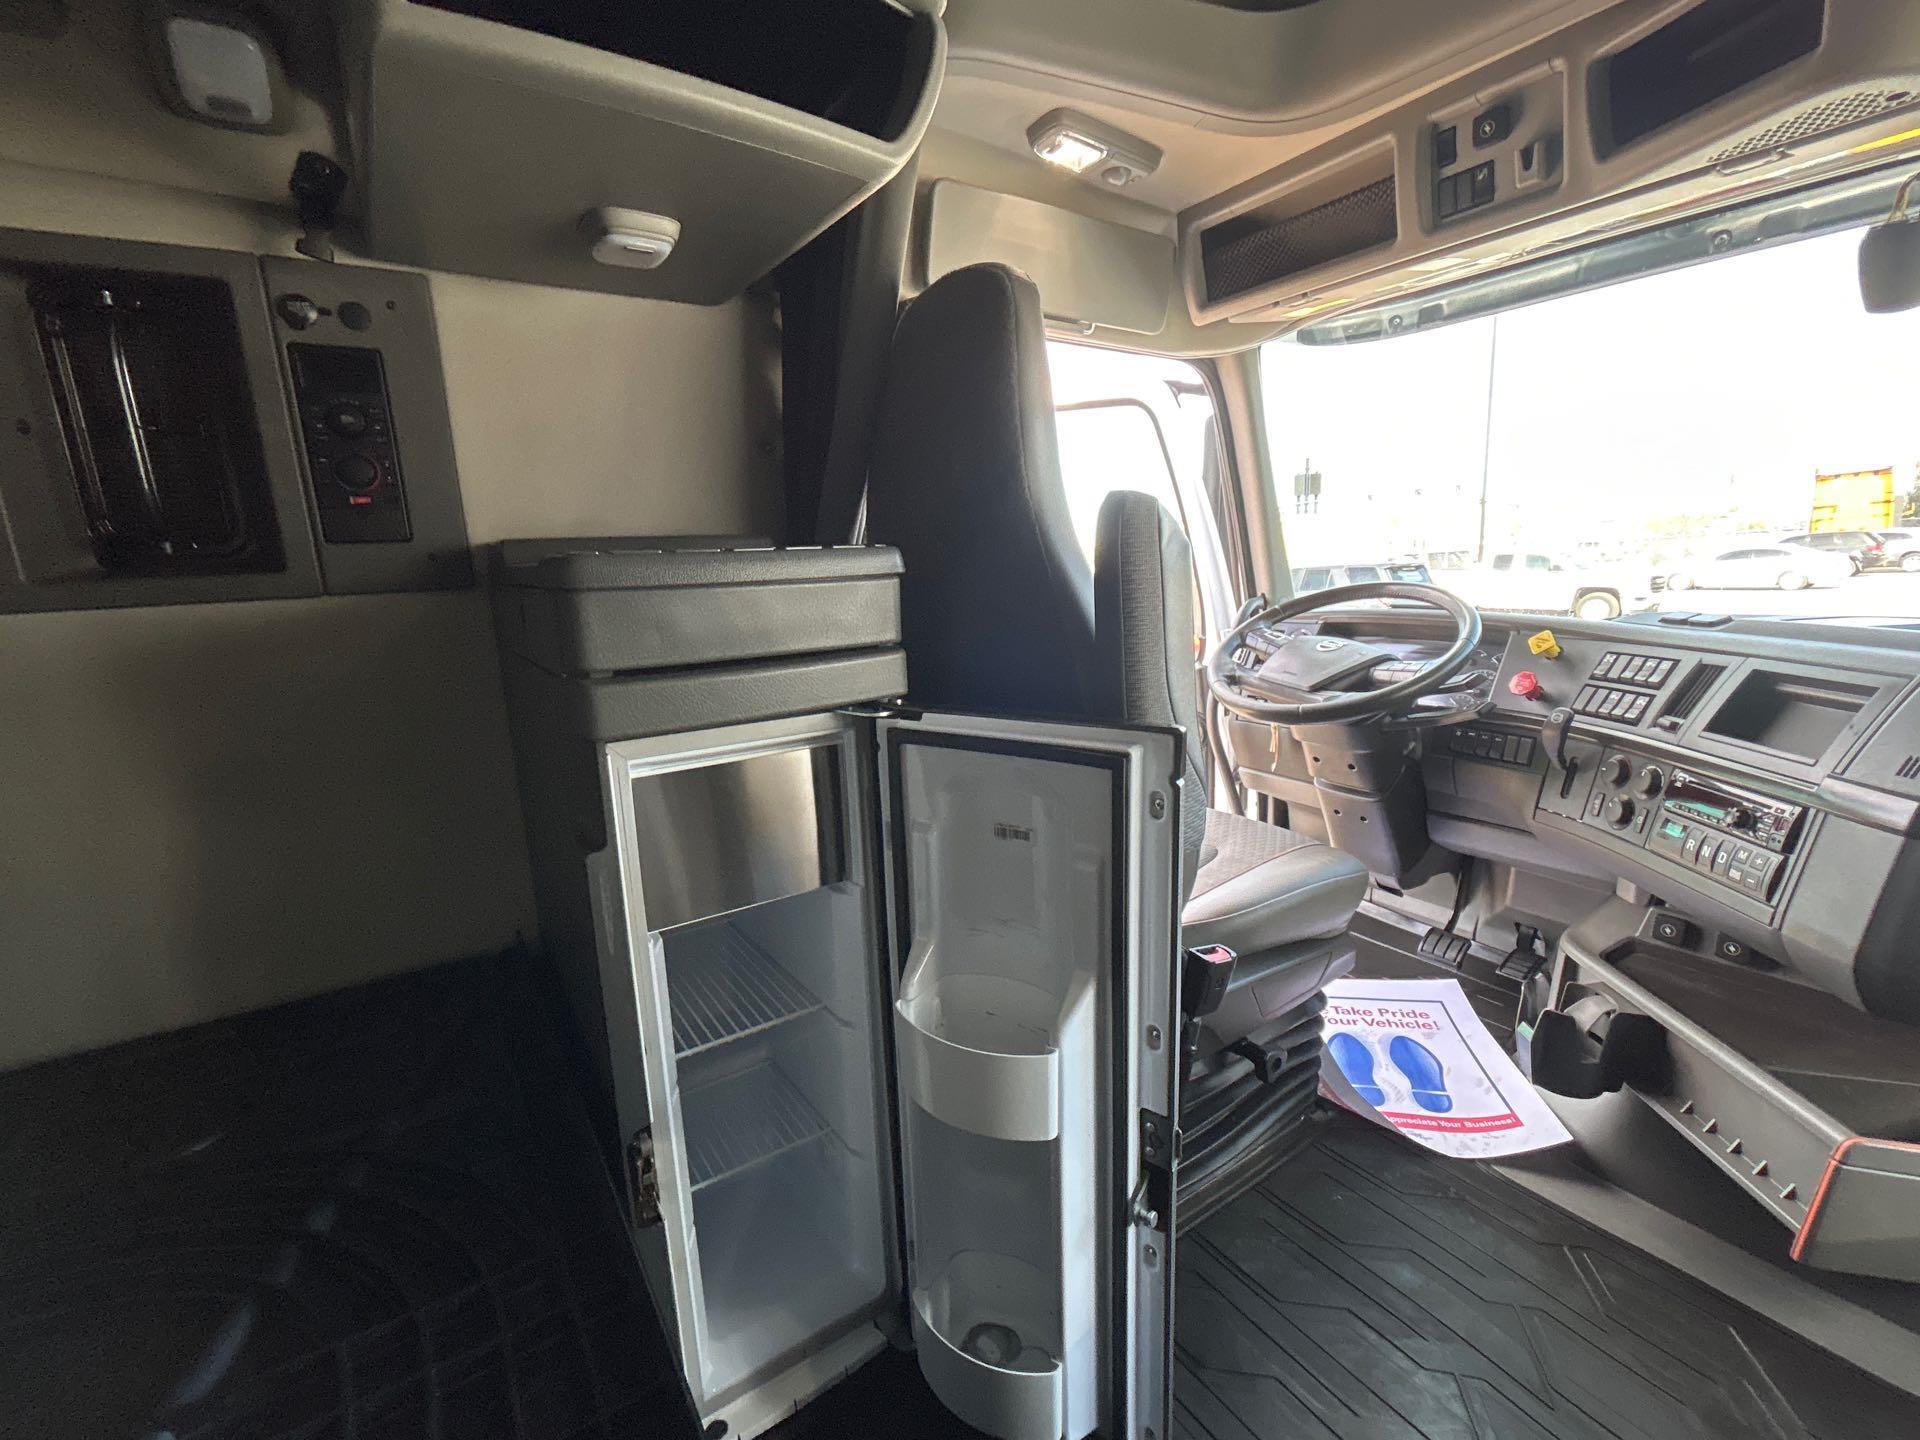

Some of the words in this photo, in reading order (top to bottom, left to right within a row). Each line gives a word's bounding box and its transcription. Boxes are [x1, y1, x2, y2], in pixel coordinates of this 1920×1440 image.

[1686, 839, 1695, 851] R
[1701, 846, 1710, 858] N
[1718, 852, 1727, 864] D
[1330, 1005, 1373, 1017] Take
[1377, 1008, 1430, 1019] Pride
[1324, 1017, 1359, 1026] our
[1361, 1018, 1441, 1031] Vehicle!
[1389, 1117, 1438, 1127] ppreciate
[1438, 1120, 1461, 1128] Your
[1463, 1117, 1516, 1128] Business!
